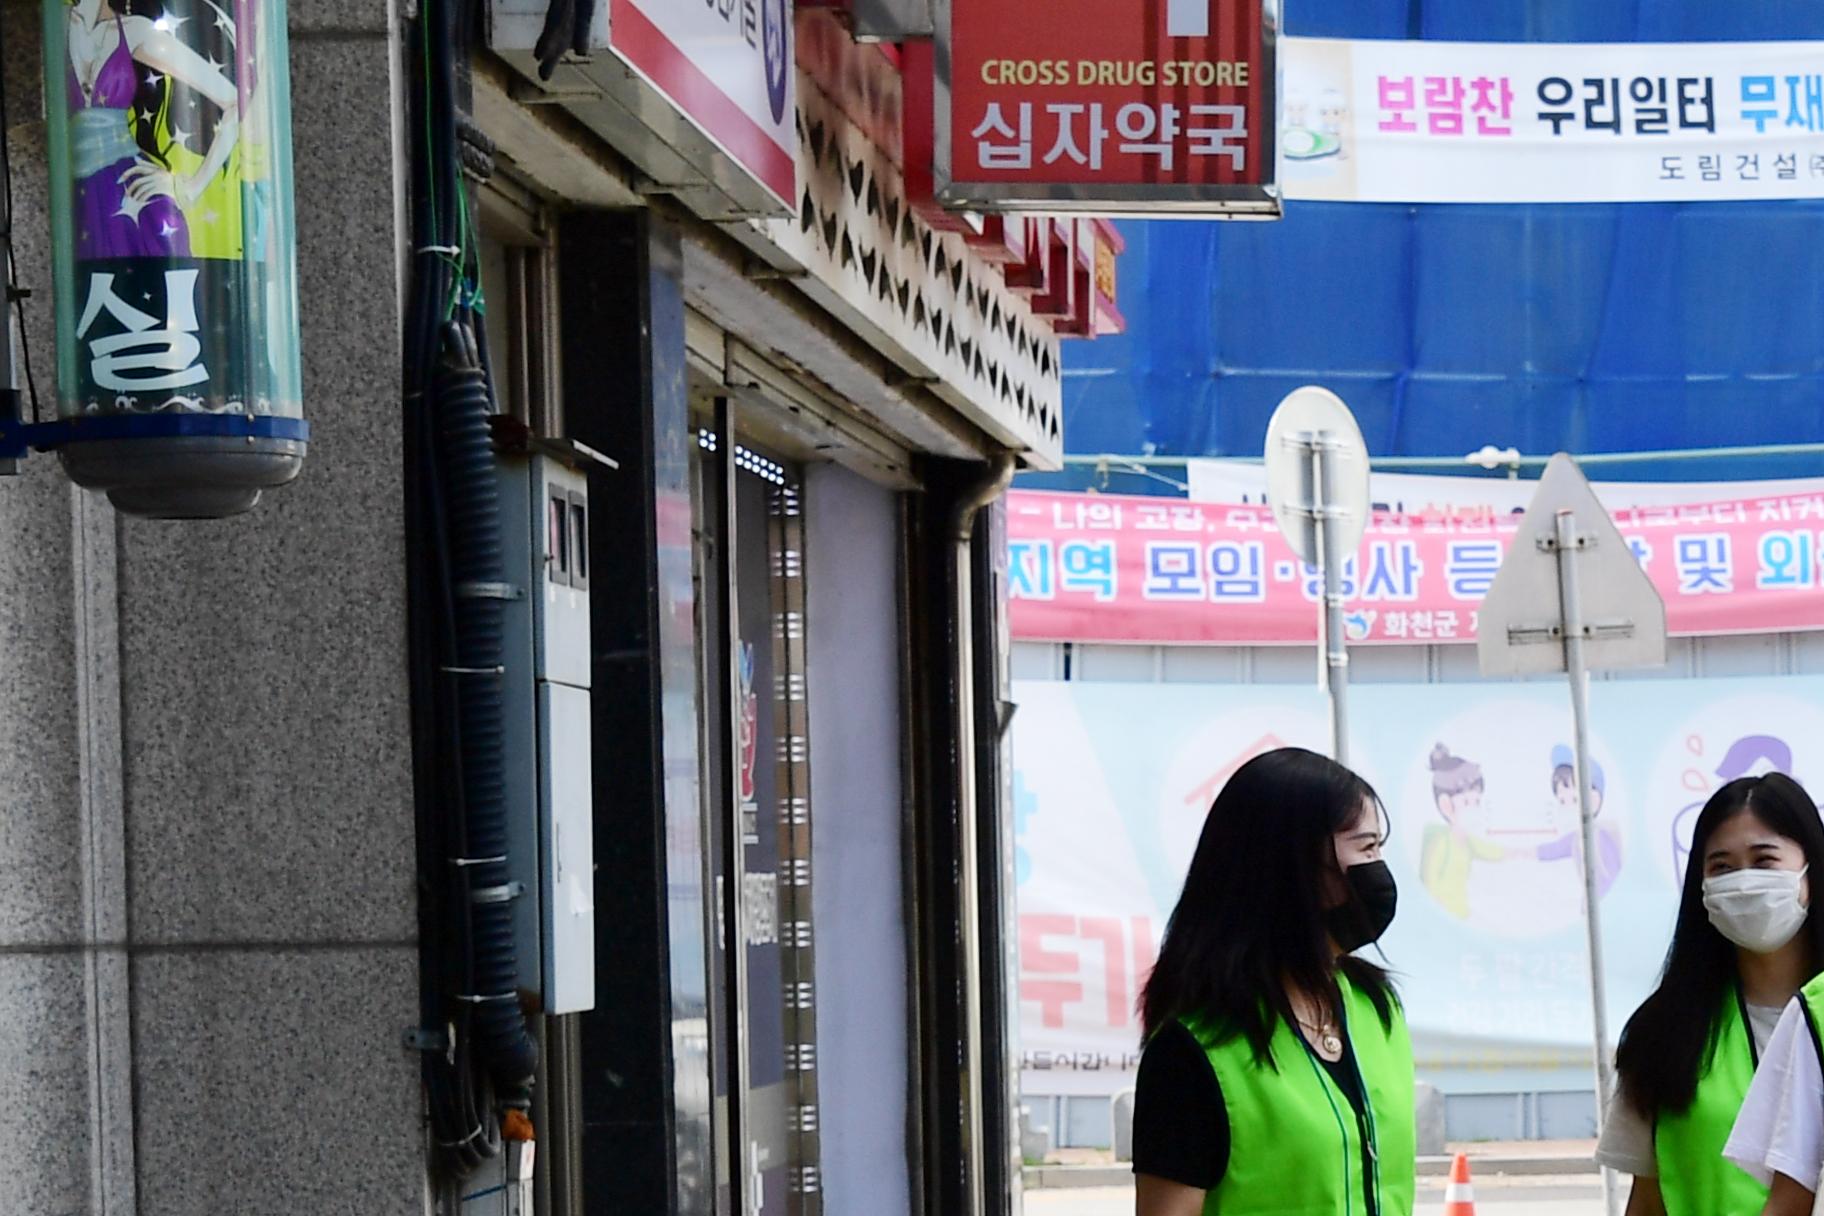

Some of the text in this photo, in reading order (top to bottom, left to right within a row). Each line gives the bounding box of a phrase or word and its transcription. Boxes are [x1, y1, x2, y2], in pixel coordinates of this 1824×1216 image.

[981, 60, 1248, 86] CROSS DRUG STORE
[1378, 75, 1514, 135] 보람찬
[1536, 76, 1716, 135] 우리일터
[971, 102, 1248, 171] 십자약국
[76, 268, 208, 391] 실
[1053, 502, 1122, 530] 나의
[1449, 544, 1501, 595] 등
[1679, 537, 1728, 588] 및
[1384, 612, 1459, 638] 화천군
